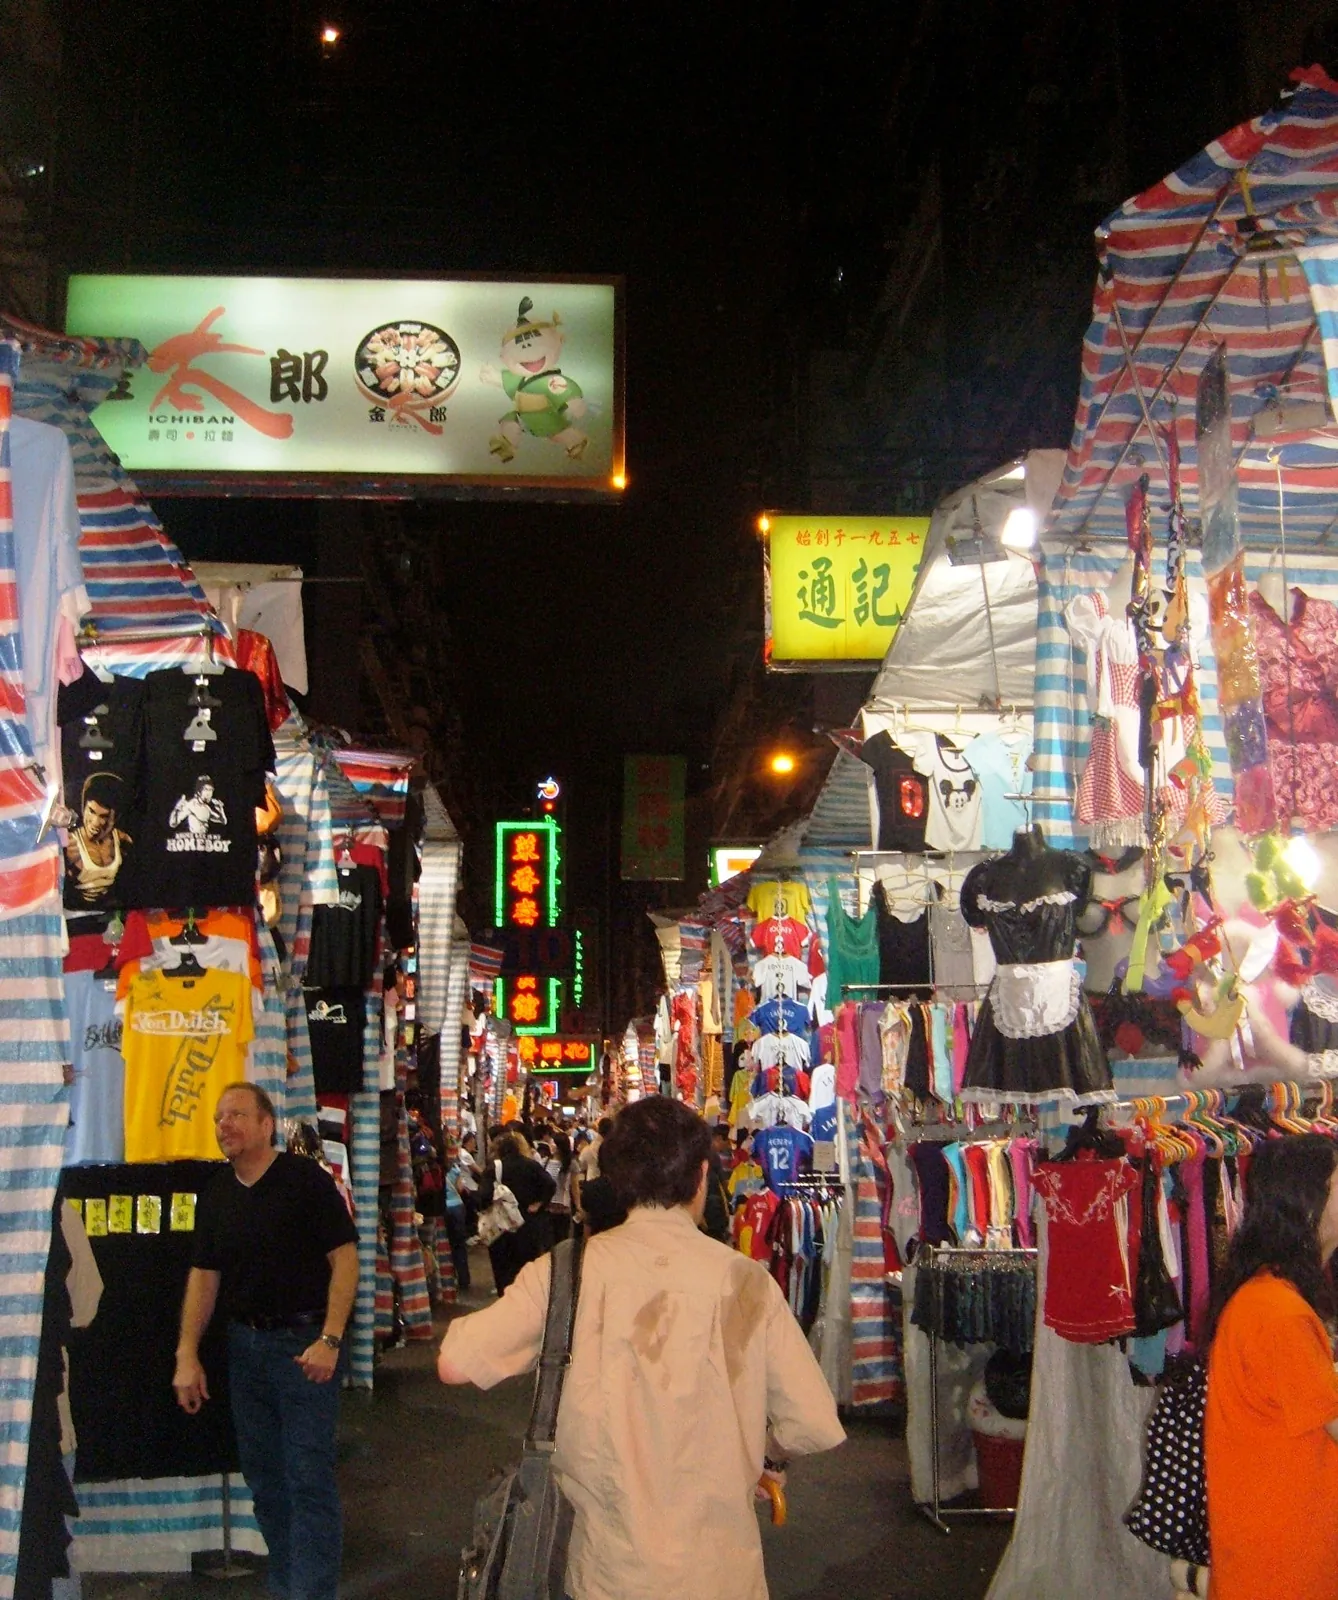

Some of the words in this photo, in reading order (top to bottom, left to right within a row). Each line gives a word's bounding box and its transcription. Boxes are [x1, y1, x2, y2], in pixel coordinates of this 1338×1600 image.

[796, 556, 920, 629] 通記
[167, 838, 232, 853] HOMEBOY
[769, 1147, 790, 1170] 12
